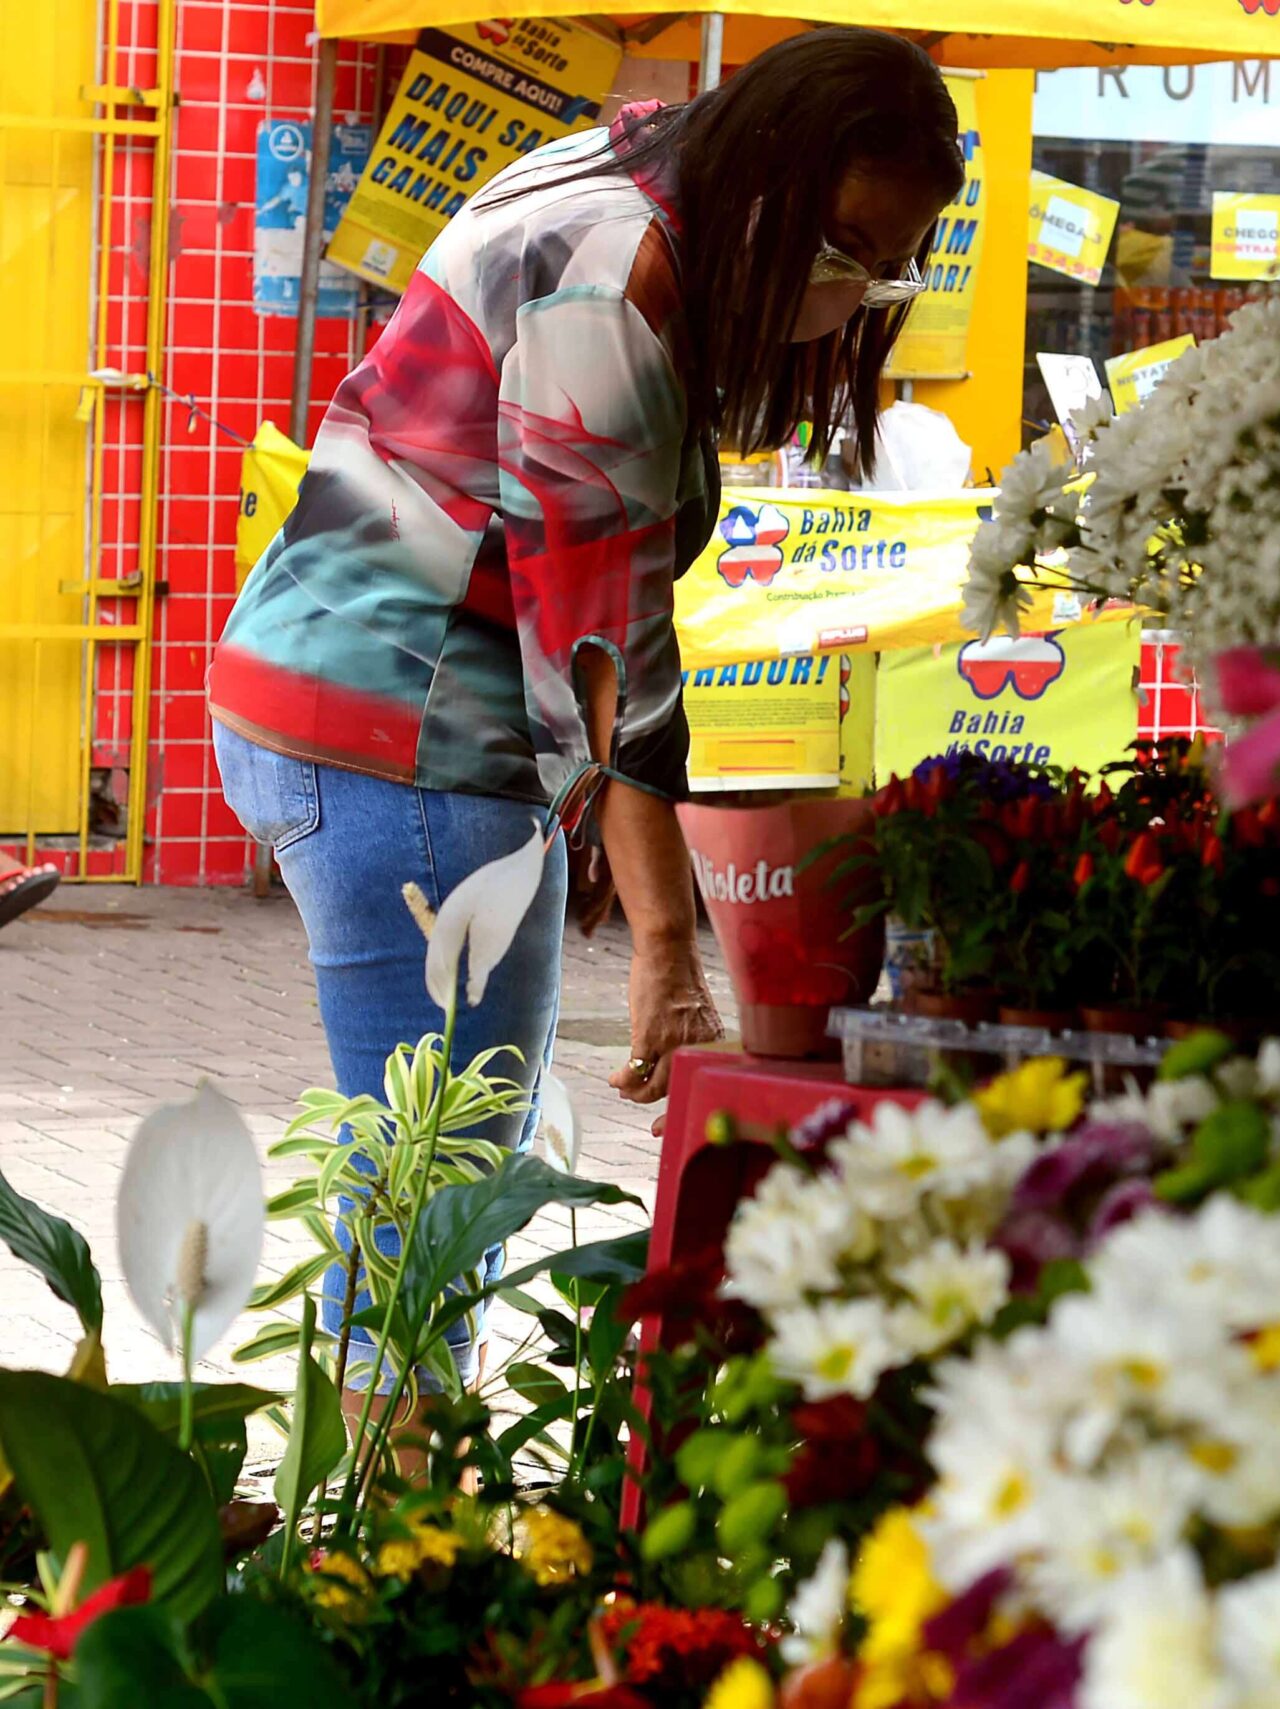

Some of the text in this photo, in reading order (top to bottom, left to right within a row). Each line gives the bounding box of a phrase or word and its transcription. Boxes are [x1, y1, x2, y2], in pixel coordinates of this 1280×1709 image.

[522, 40, 568, 72] Sorte
[450, 47, 512, 88] COMPRE
[514, 78, 563, 112] AQUI!
[405, 72, 556, 154] DAQUI SA
[387, 113, 488, 183] MAIS
[799, 506, 872, 536] Bahia
[790, 538, 907, 572] dá Sorte
[948, 709, 1025, 734] Bahia
[974, 739, 1051, 766] Sorte
[689, 847, 793, 905] Violeta
